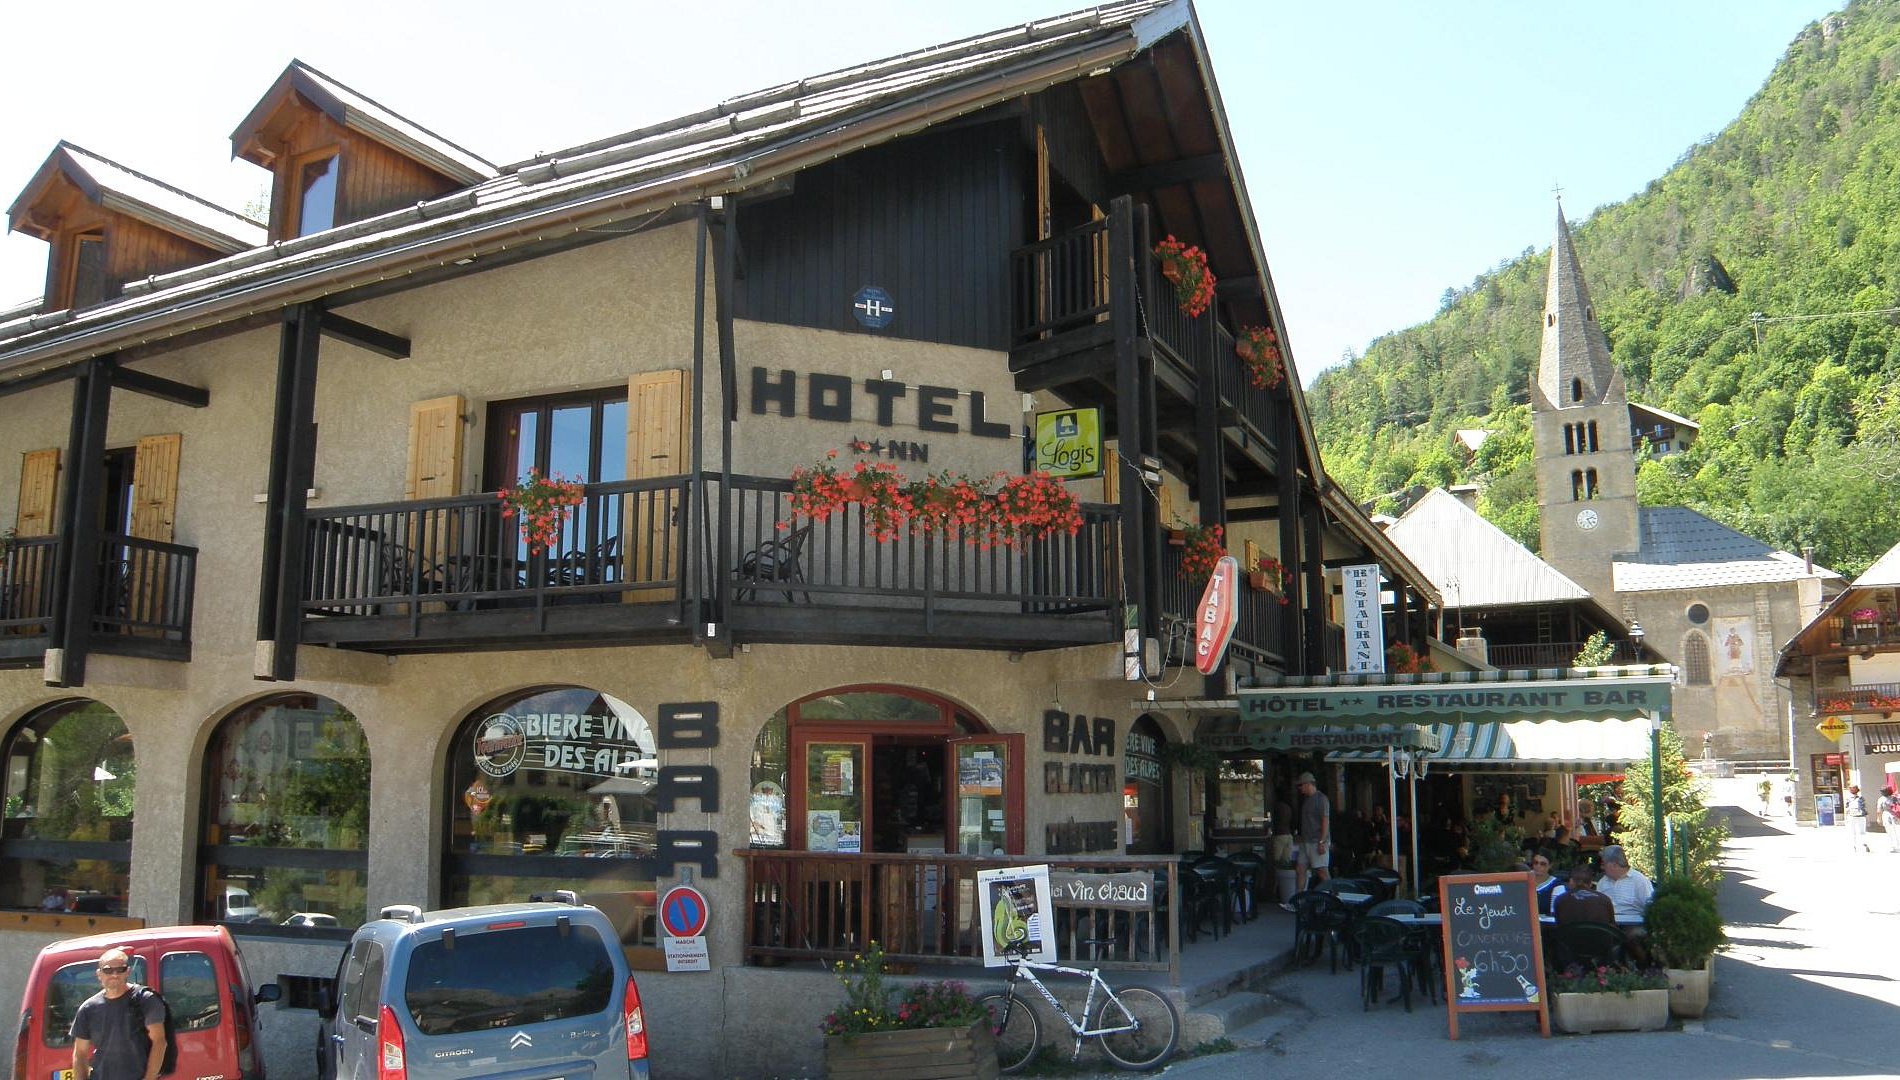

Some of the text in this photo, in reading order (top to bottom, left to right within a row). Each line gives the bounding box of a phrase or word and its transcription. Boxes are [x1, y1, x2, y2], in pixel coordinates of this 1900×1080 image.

[866, 299, 880, 317] H
[752, 367, 1011, 439] HOTEL
[889, 440, 929, 463] NN
[1039, 439, 1095, 471] Logis
[1198, 574, 1223, 656] TABAC
[1352, 569, 1372, 670] RESTAURANT
[1249, 688, 1647, 713] HÔTEL RESTAURANT BAR
[526, 713, 592, 739] BIERE
[1044, 709, 1116, 757] BAR
[1290, 732, 1404, 746] RESTAURANT
[544, 744, 586, 770] DES
[657, 701, 719, 878] BAR
[1067, 879, 1096, 901] Vin
[1454, 897, 1475, 916] Le
[1474, 948, 1529, 975] 6h30
